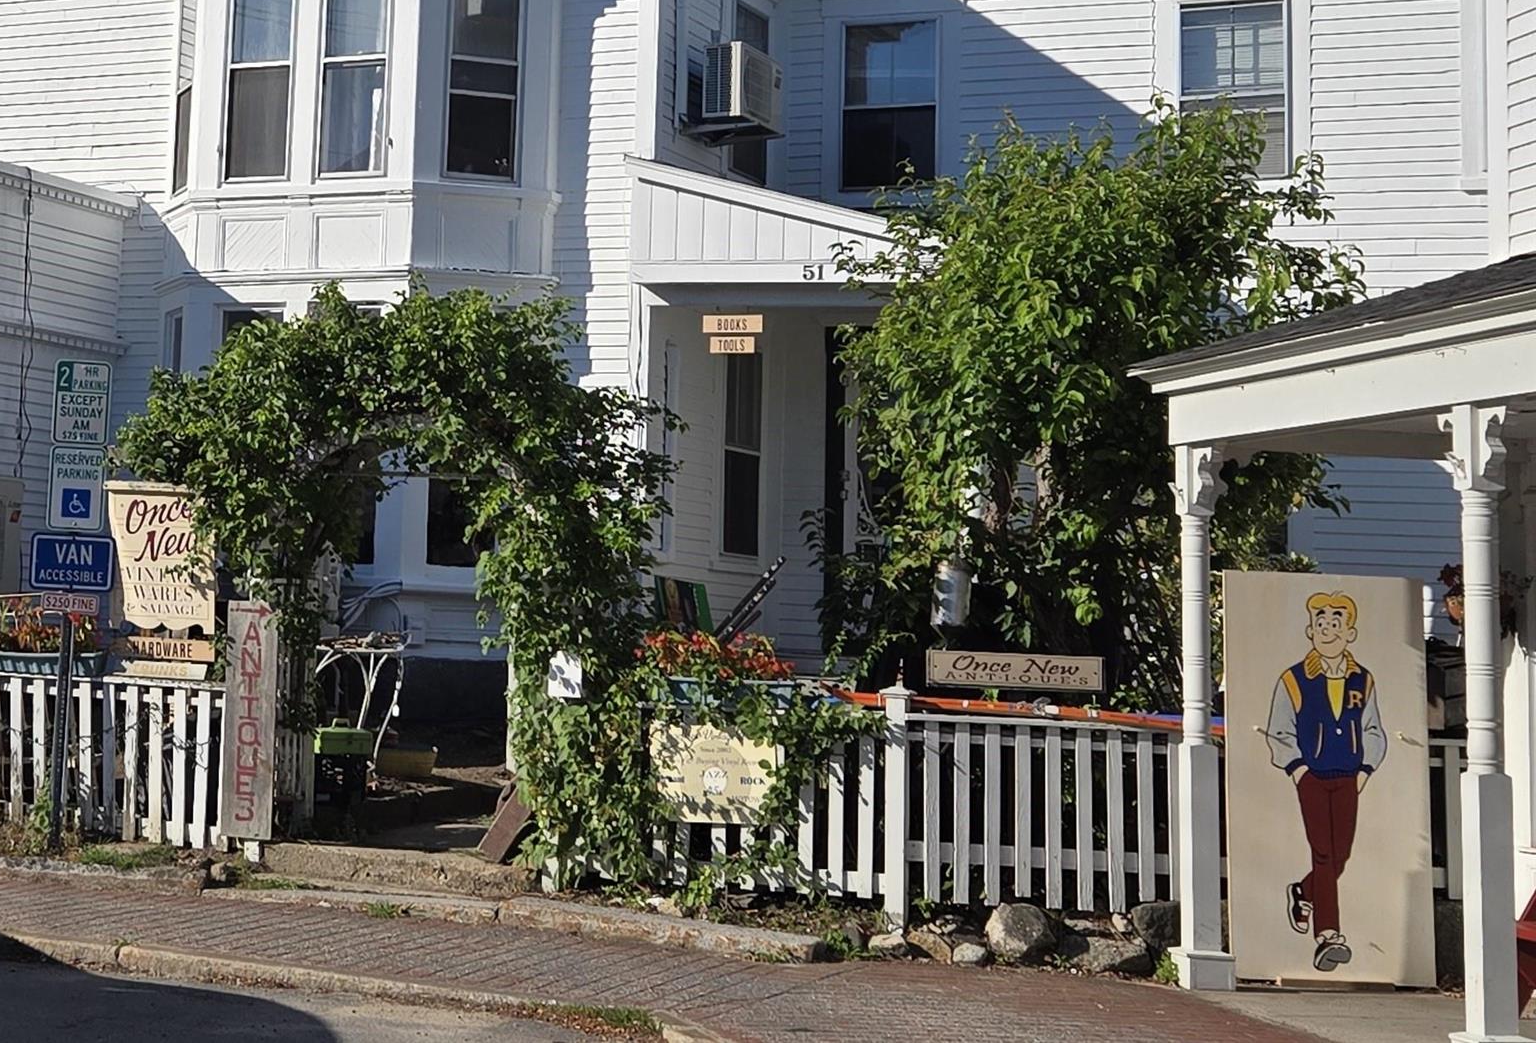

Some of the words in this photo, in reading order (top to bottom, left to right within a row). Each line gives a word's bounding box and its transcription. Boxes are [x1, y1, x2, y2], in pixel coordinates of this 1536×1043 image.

[802, 264, 825, 281] 51
[717, 318, 748, 331] BOOKS
[717, 339, 745, 352] TOOLS
[59, 366, 70, 387] 2
[83, 366, 100, 377] HR
[73, 379, 107, 391] PARKING
[61, 394, 104, 407] EXCEPT
[60, 406, 104, 419] SUNDAY
[72, 420, 90, 431] AM
[79, 432, 99, 441] FINE
[54, 453, 103, 467] RESERVED
[57, 468, 99, 481] PARKING
[125, 497, 193, 535] Once
[55, 543, 93, 566] VAN
[38, 569, 104, 583] ACCESSIBLE
[133, 585, 194, 602] WARES
[45, 596, 71, 609] $250
[72, 597, 95, 611] FINE
[140, 604, 199, 616] SALVAGE
[132, 640, 193, 659] HARDWARE
[951, 655, 1012, 673] Once
[1022, 658, 1080, 676] New
[1347, 690, 1363, 709] R
[234, 620, 262, 822] ANTIQUES
[700, 770, 728, 778] JAZZ
[740, 777, 766, 786] ROCK
